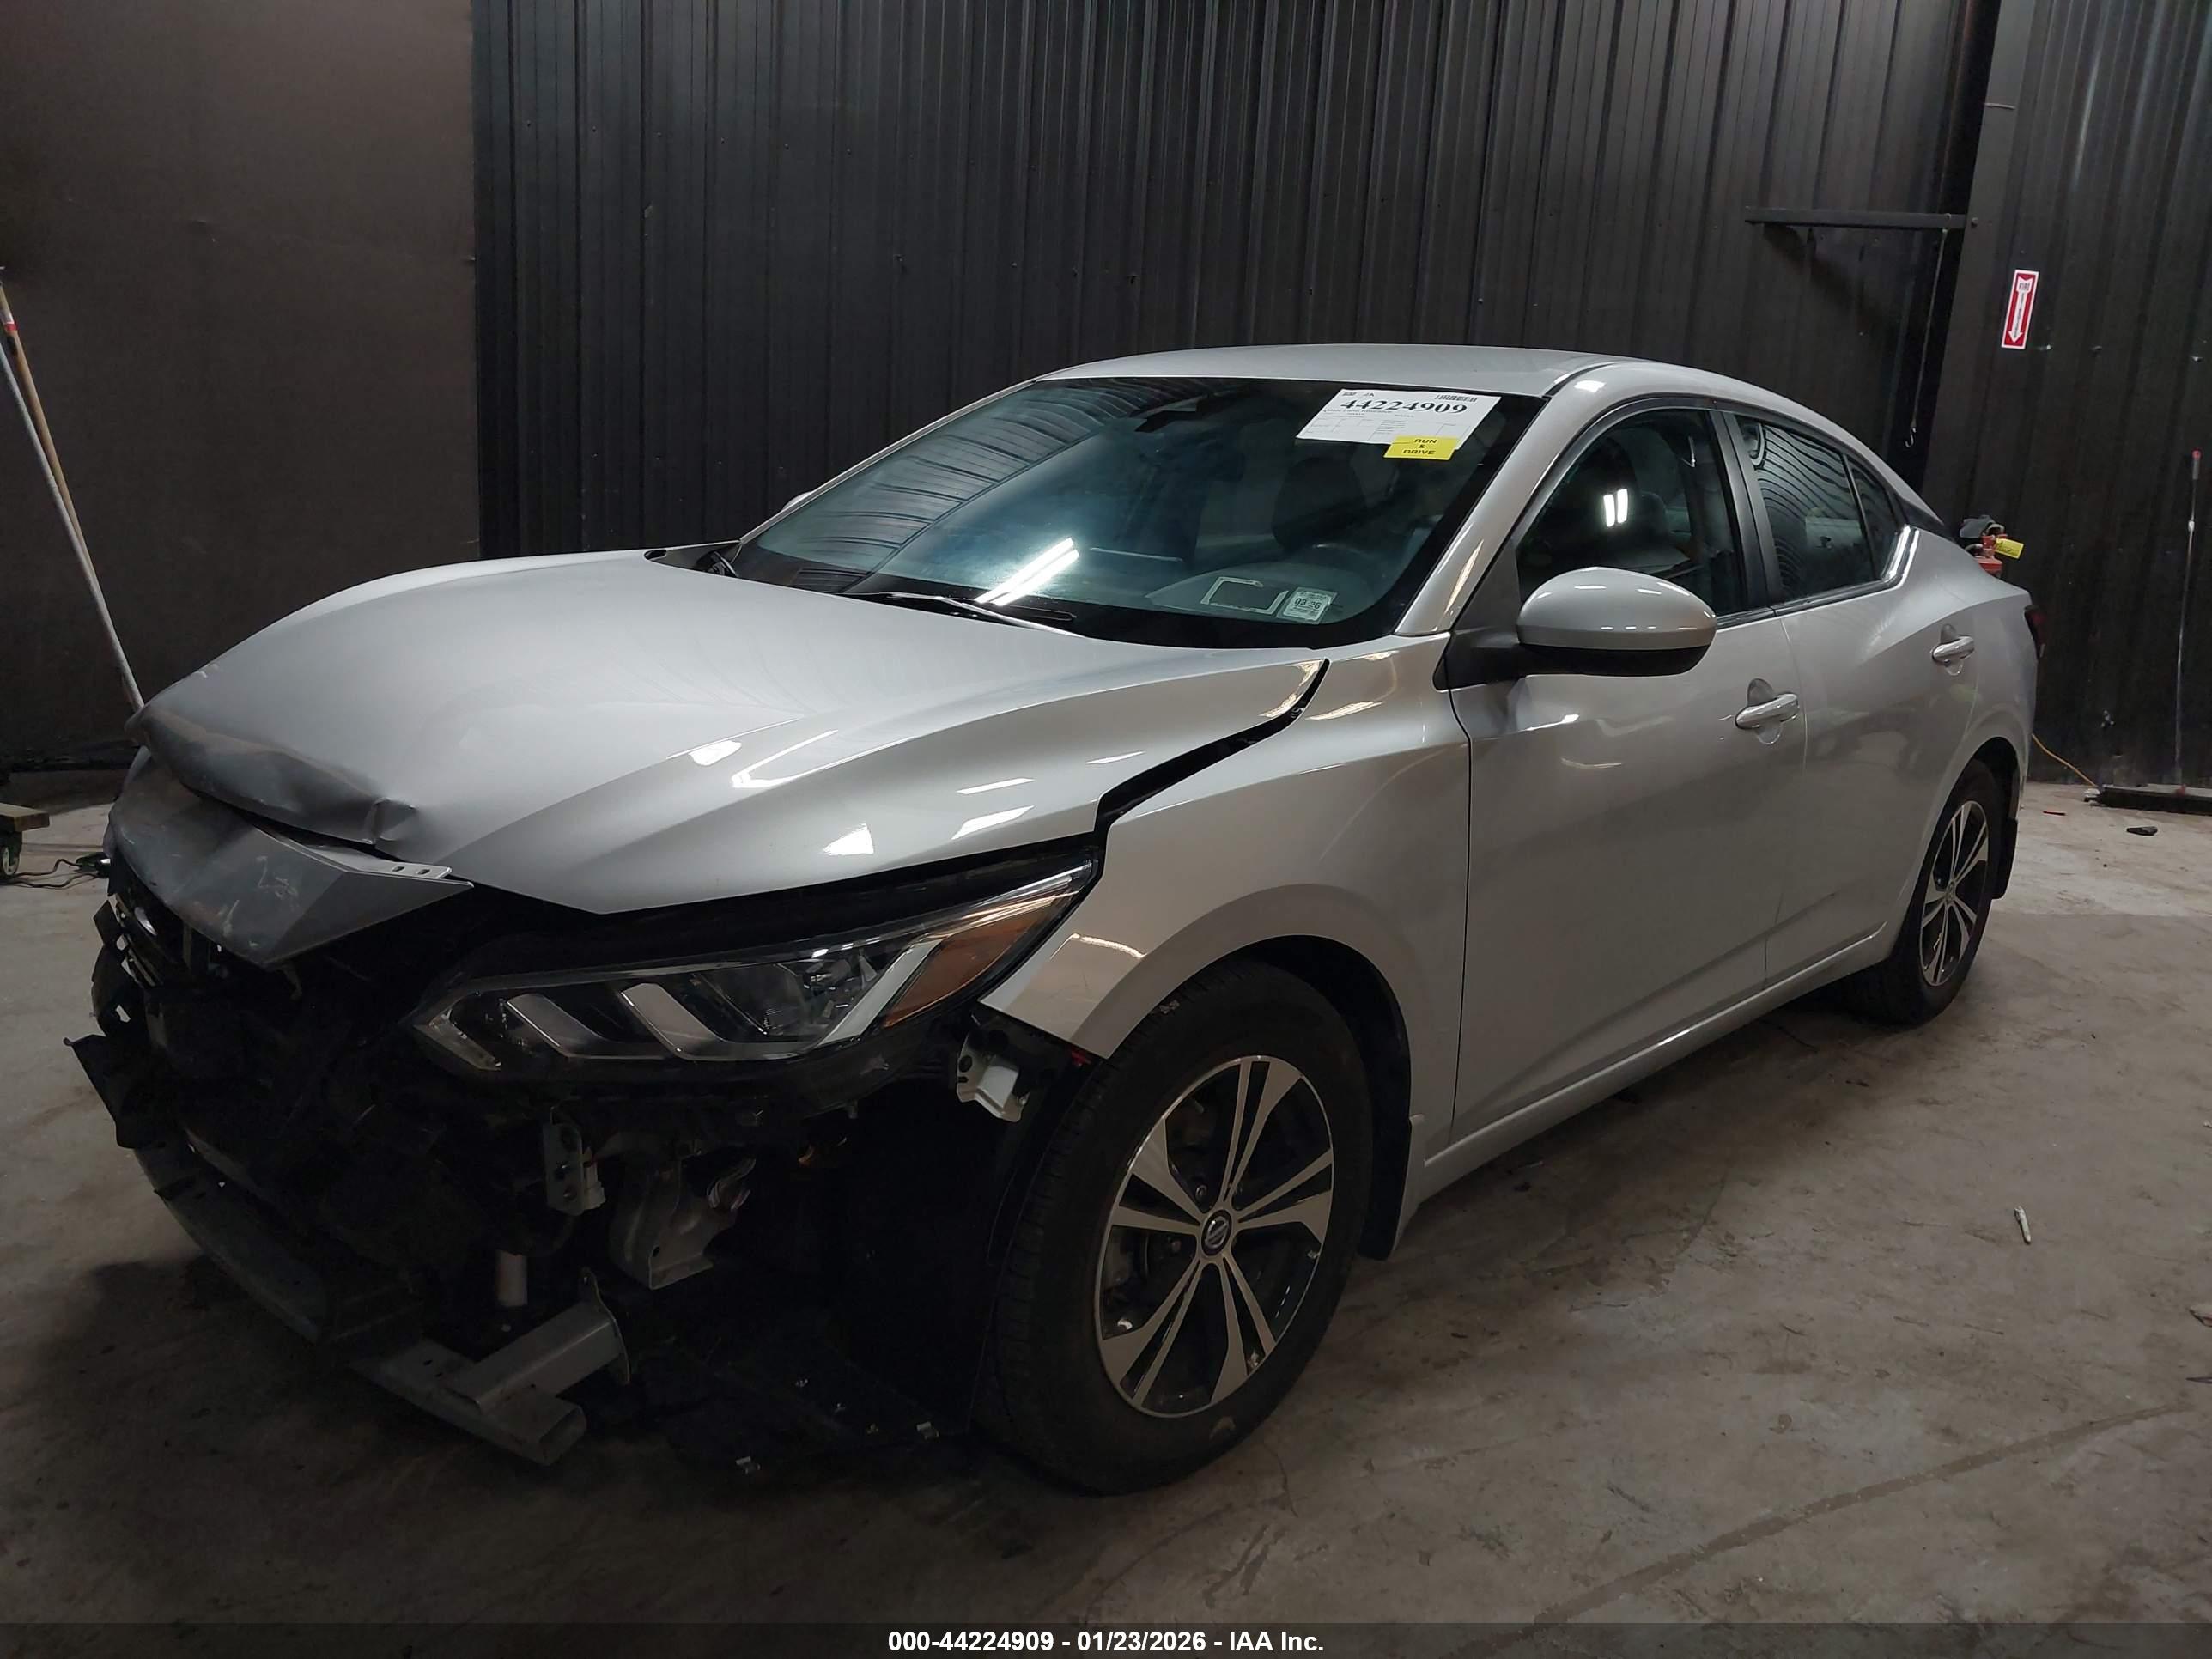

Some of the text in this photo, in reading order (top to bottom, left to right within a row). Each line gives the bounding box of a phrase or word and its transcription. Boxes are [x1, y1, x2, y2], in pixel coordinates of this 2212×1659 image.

[1340, 399, 1468, 414] 44224909
[1295, 598, 1322, 610] 03 26
